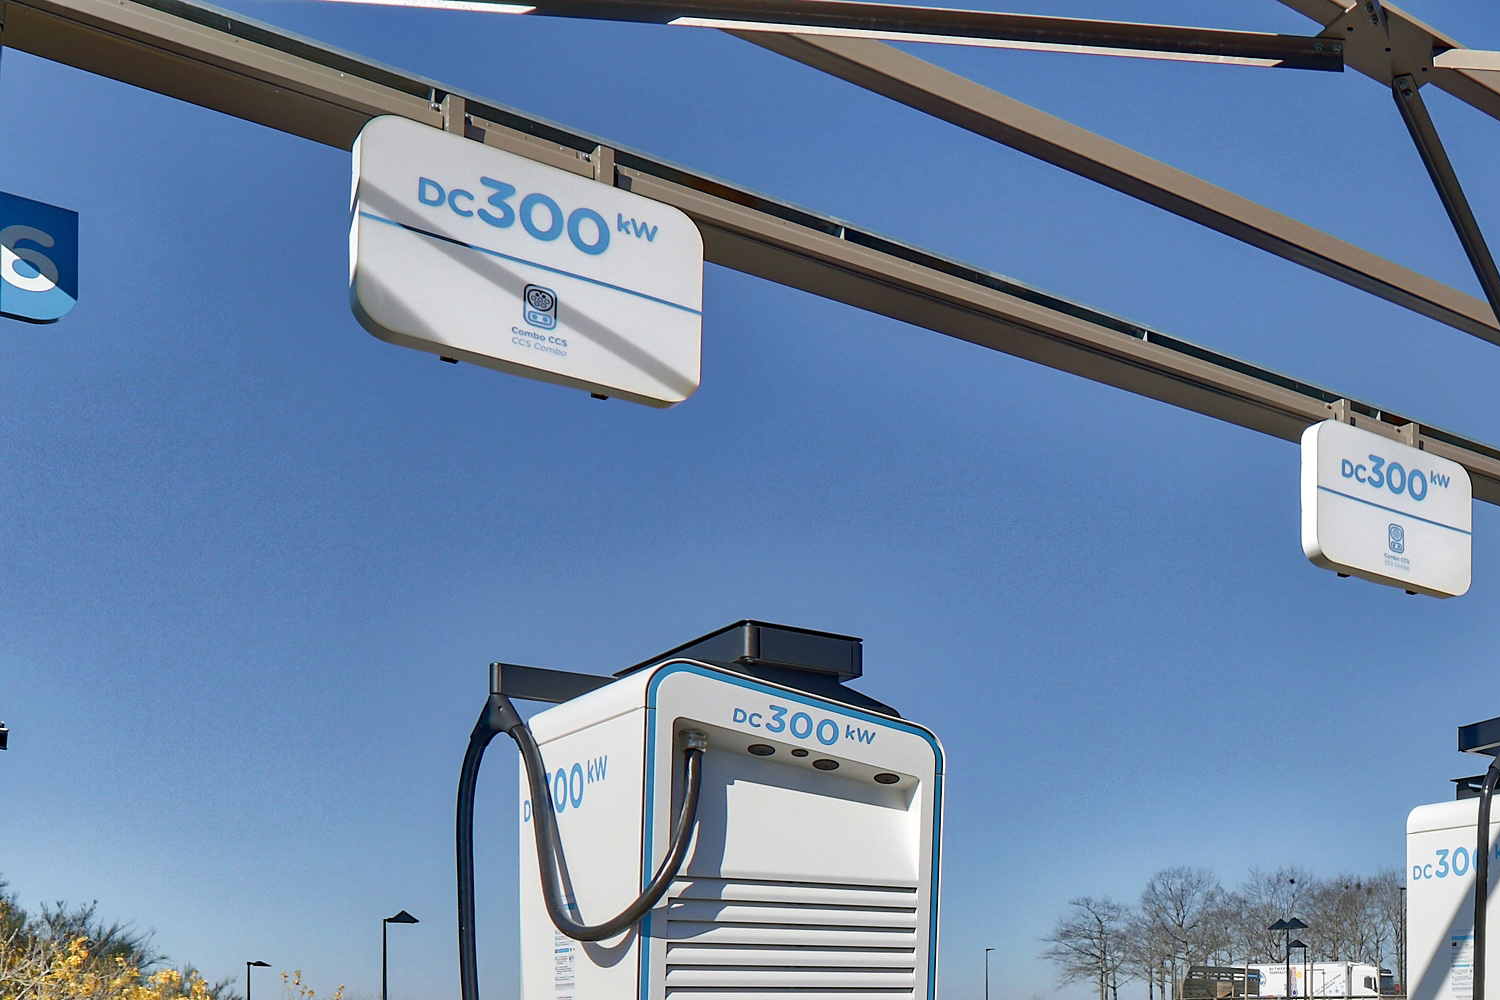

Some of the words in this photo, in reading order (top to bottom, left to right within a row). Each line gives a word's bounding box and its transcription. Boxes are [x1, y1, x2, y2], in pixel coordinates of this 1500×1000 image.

[511, 326, 545, 341] Combo
[548, 336, 567, 347] CCS
[511, 337, 531, 348] CCS
[534, 342, 567, 357] Combo
